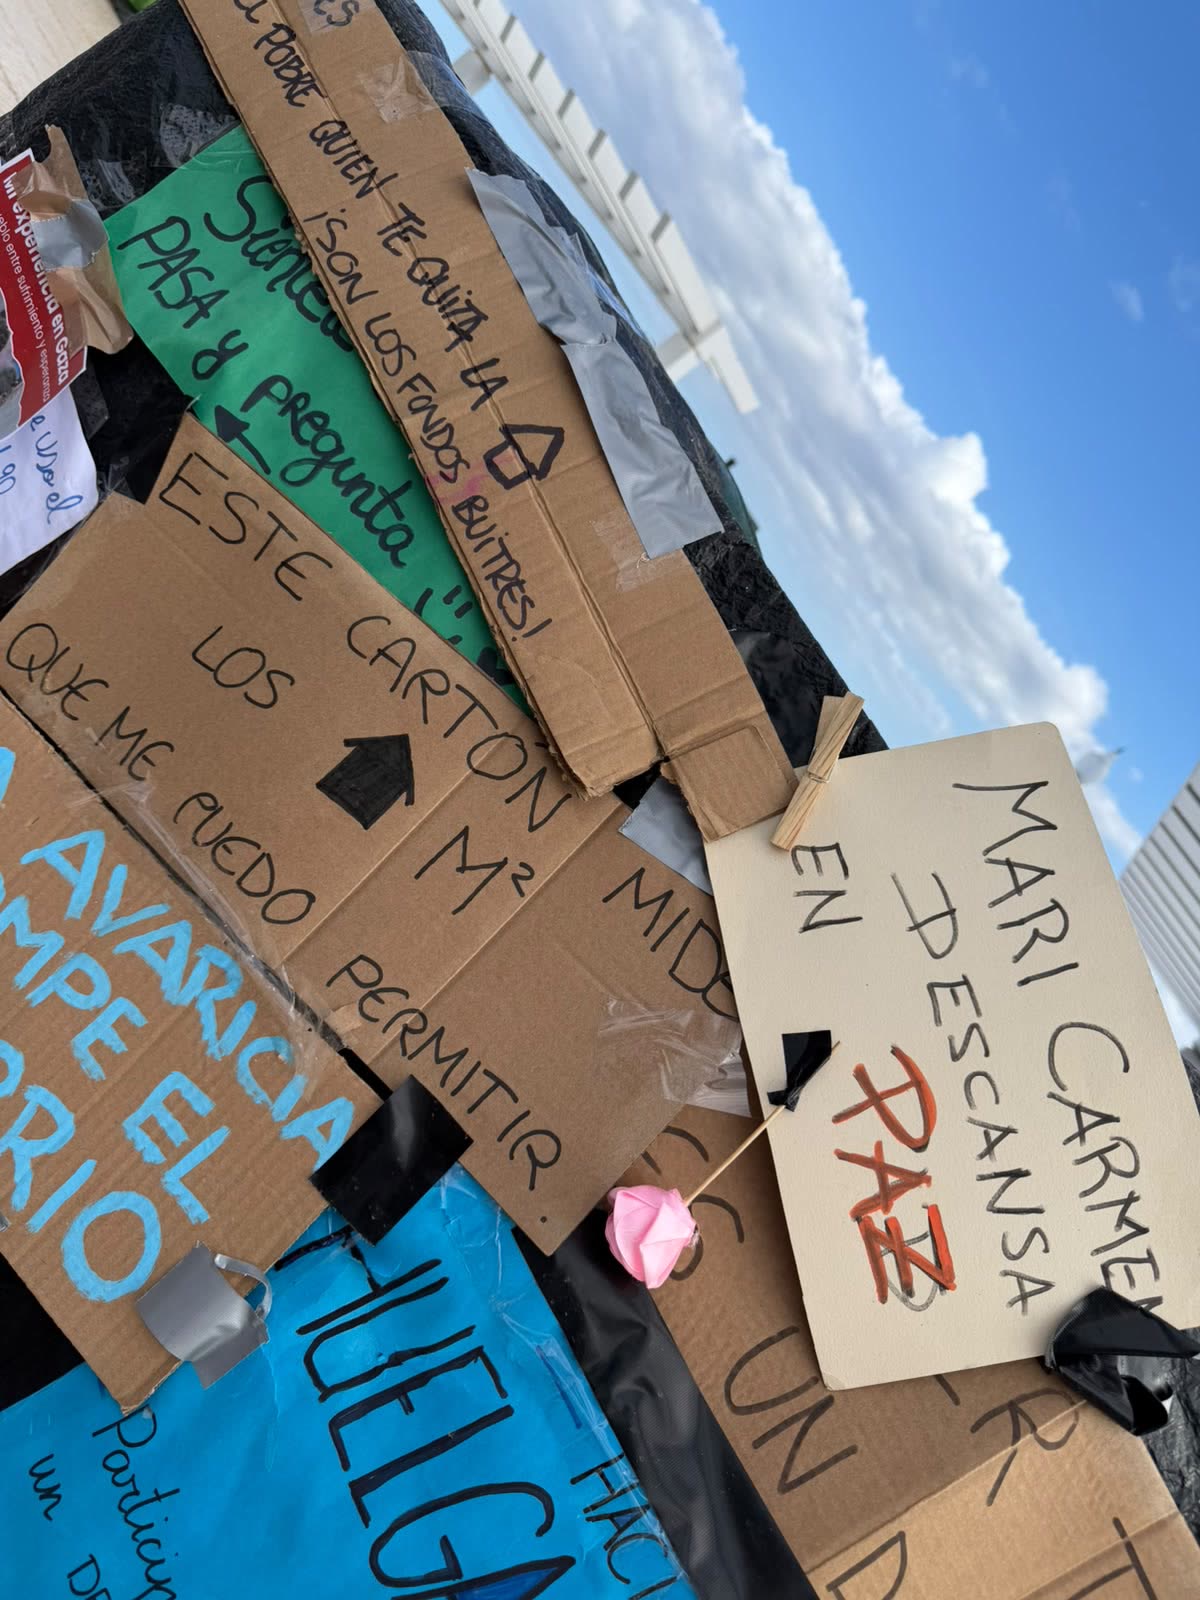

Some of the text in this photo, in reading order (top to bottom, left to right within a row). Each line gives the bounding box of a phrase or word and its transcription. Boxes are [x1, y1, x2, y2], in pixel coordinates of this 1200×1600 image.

[5, 243, 23, 275] entre
[254, 22, 329, 108] POBRE
[308, 119, 398, 200] QUIEN
[377, 202, 427, 256] TE
[460, 357, 509, 411] LA
[17, 274, 45, 340] sufrimiento
[35, 340, 46, 349] y
[51, 313, 65, 340] en
[56, 336, 70, 386] Gaza
[39, 348, 51, 403] esperanza
[365, 311, 417, 376] LOS
[397, 372, 471, 483] FONDOS
[158, 451, 334, 601] ESTE
[191, 625, 296, 709] LOS
[6, 622, 110, 721] QUE
[94, 705, 175, 782] ME
[172, 791, 317, 926] PUEDO
[790, 840, 863, 934] EN
[950, 780, 1079, 988] MARI
[0, 873, 231, 1225] MPE EL
[19, 829, 356, 1173] AVARICIA
[723, 1324, 860, 1495] UN
